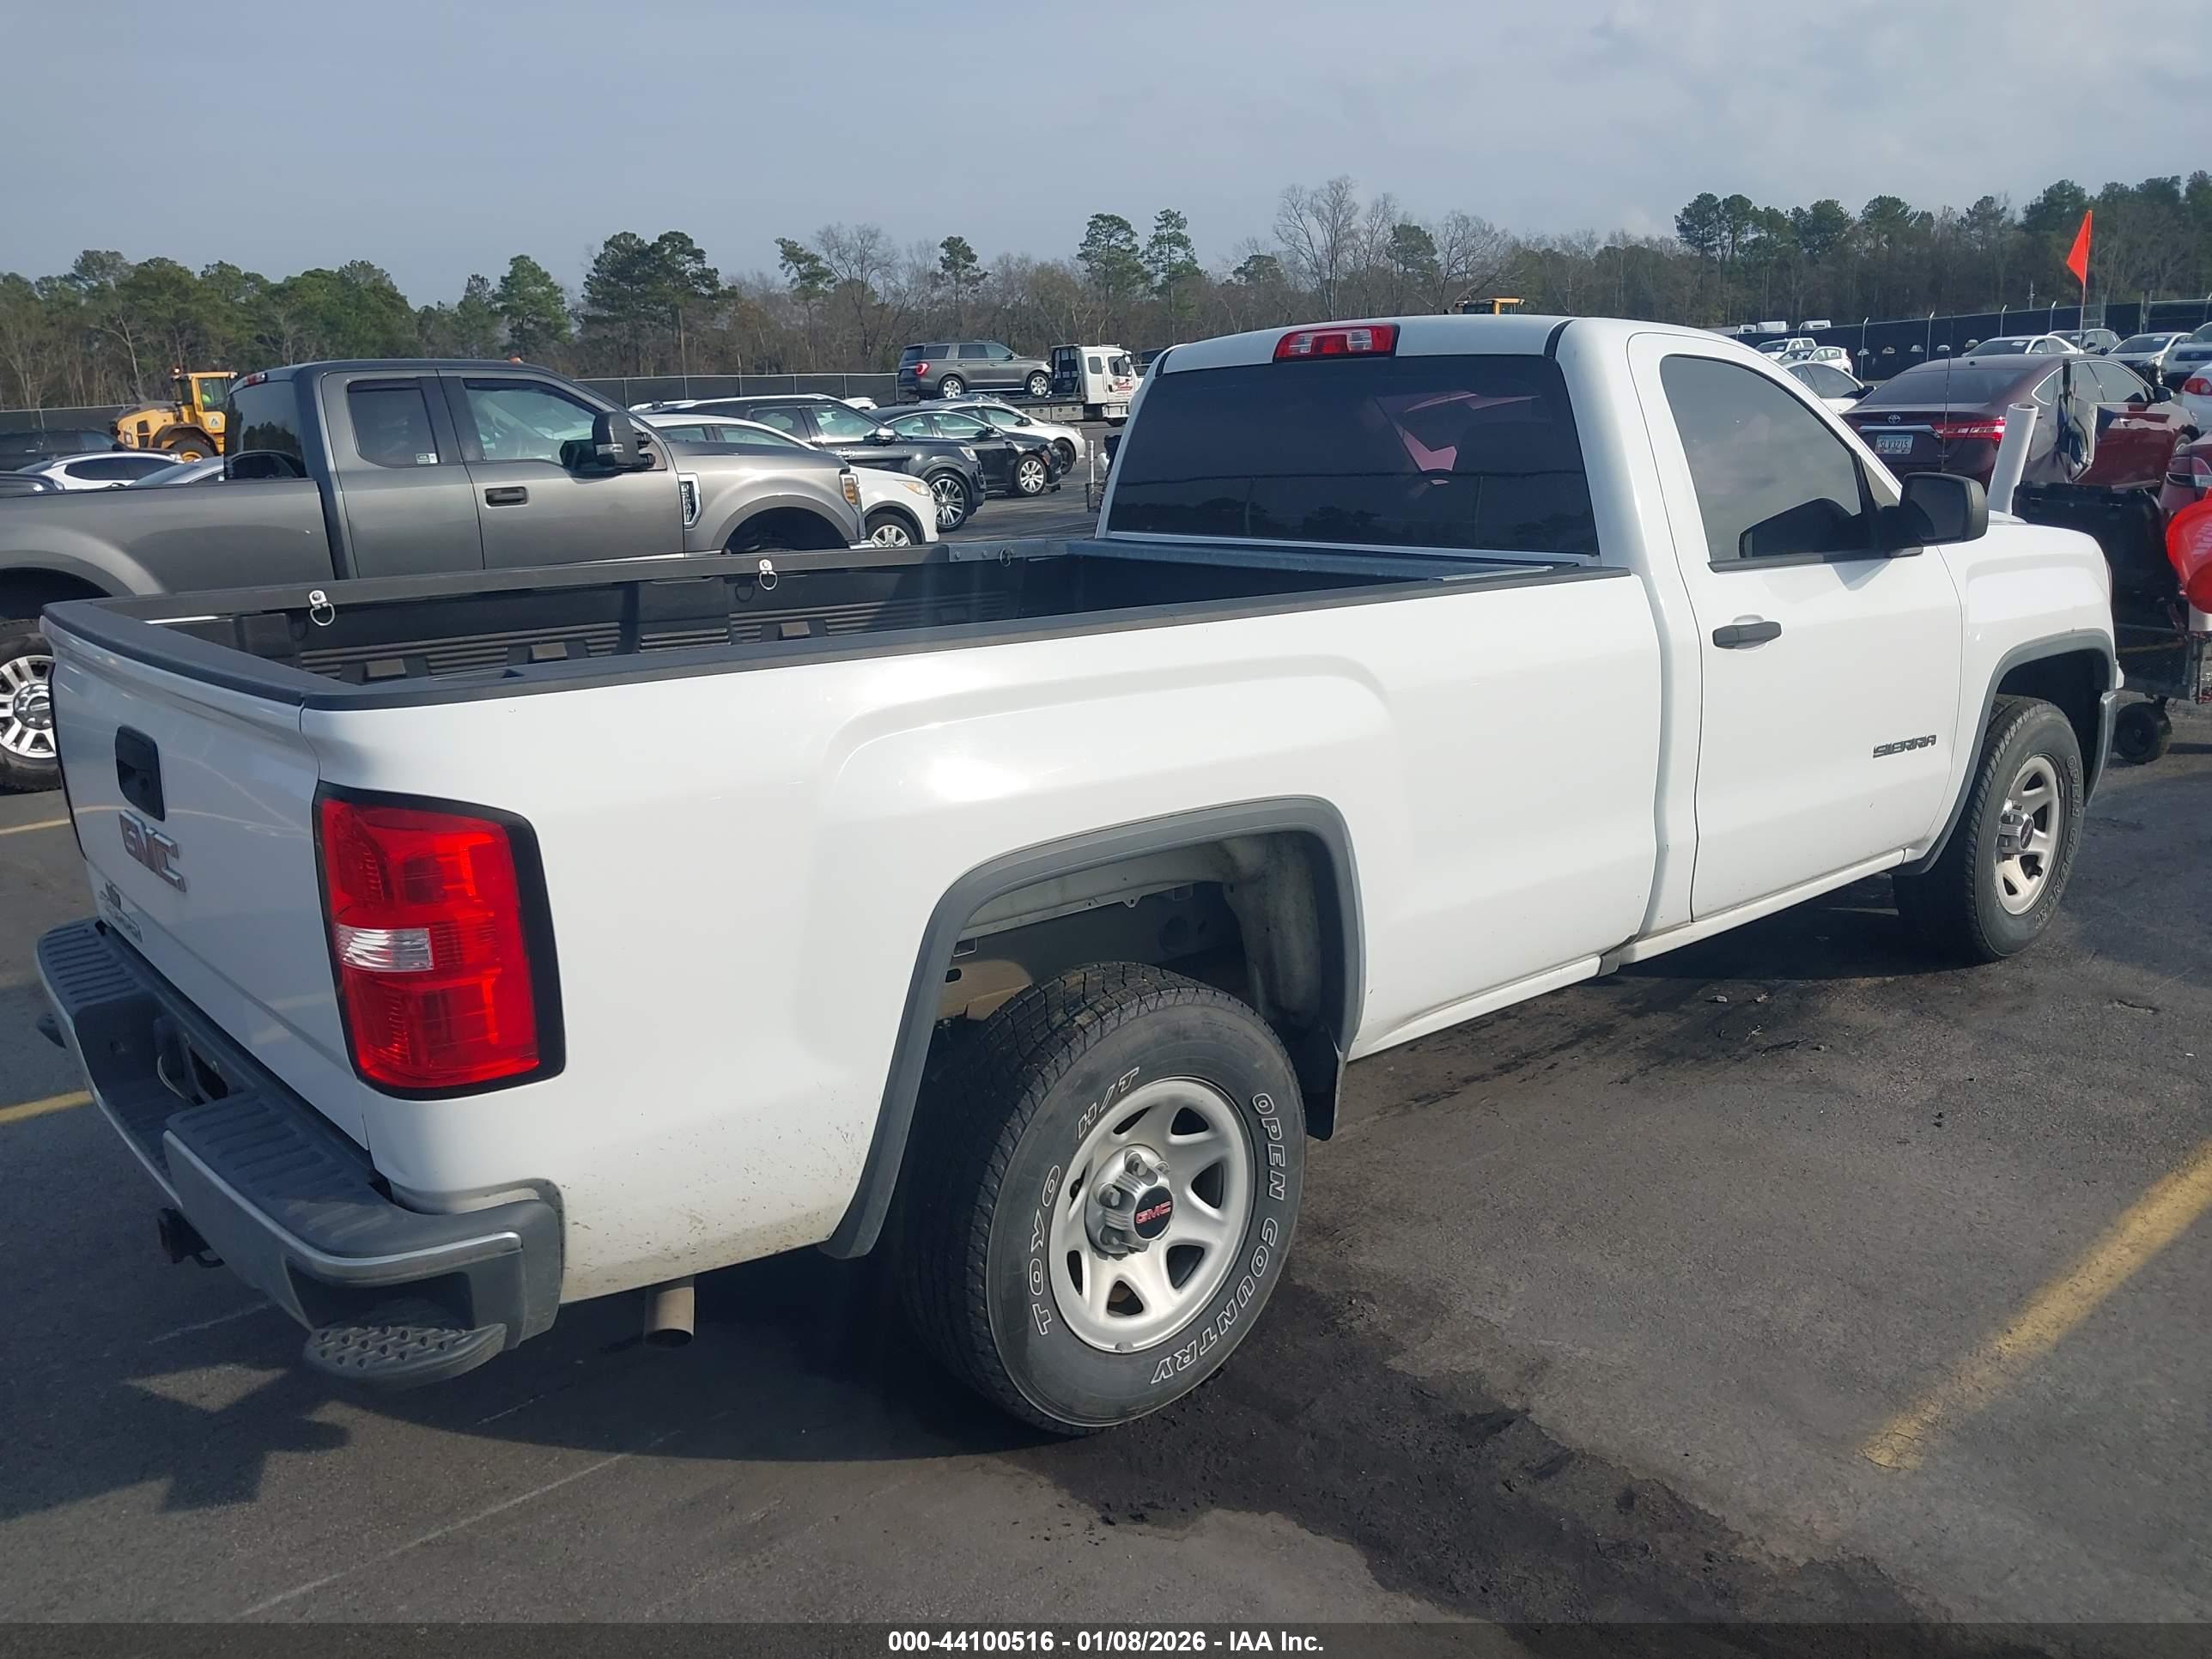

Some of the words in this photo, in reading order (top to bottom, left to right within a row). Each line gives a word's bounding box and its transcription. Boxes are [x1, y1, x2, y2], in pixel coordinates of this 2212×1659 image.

[1872, 734, 1937, 759] SIERRA
[118, 809, 187, 893] GMC
[1251, 1092, 1287, 1201] OPEN
[1029, 1164, 1061, 1336] TOYO
[1135, 1200, 1171, 1224] GMC
[1149, 1218, 1279, 1385] COUNTRY
